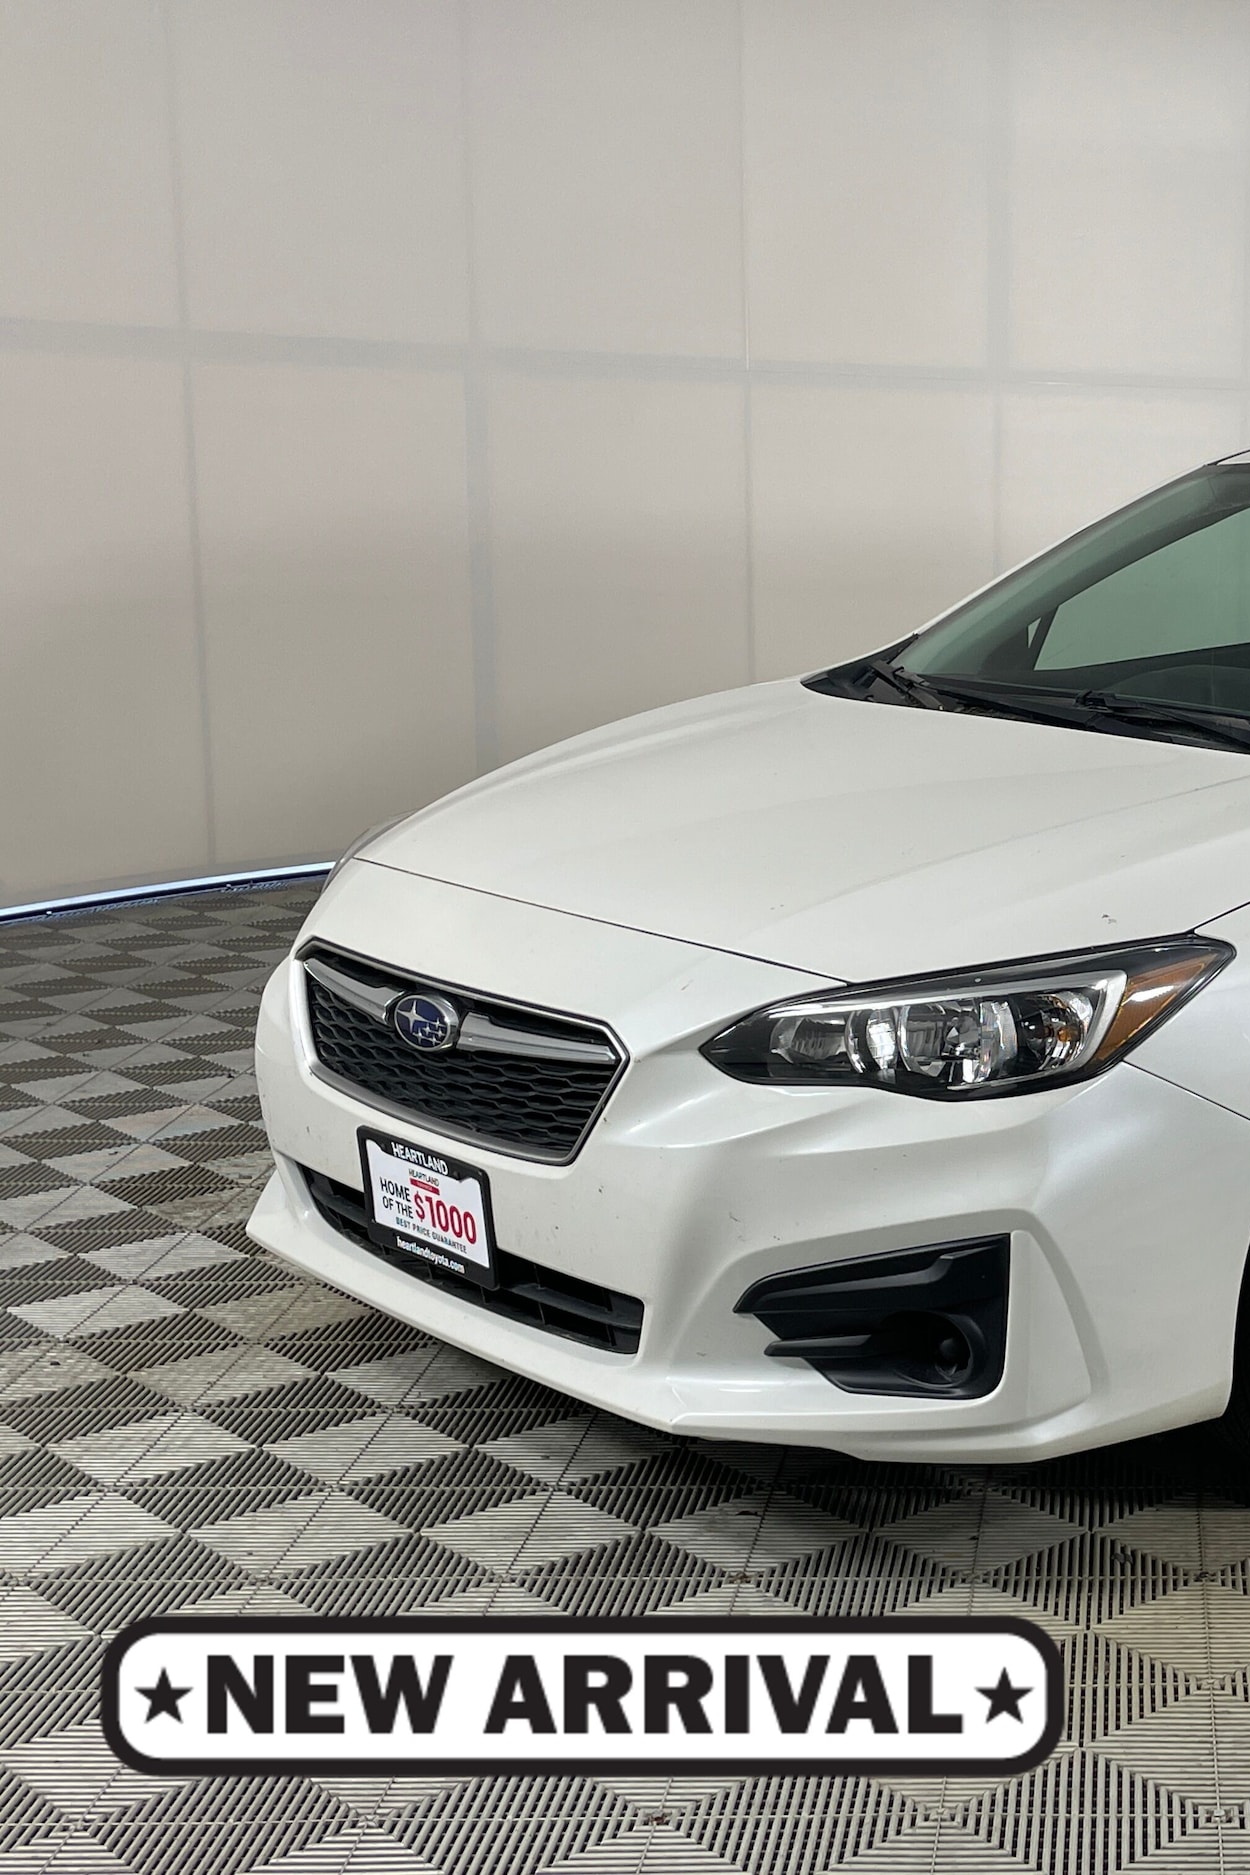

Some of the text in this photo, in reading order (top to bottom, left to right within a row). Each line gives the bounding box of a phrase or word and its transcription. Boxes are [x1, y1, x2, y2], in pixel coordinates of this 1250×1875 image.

[391, 1142, 448, 1175] HEARTLAND
[380, 1178, 411, 1202] HOME
[408, 1169, 440, 1187] HEARTLAND
[382, 1195, 415, 1219] OF THE
[414, 1191, 477, 1245] $1000
[396, 1216, 467, 1255] BEST PRICE GUARANTEE
[396, 1235, 466, 1274] heartlandtoyota.com
